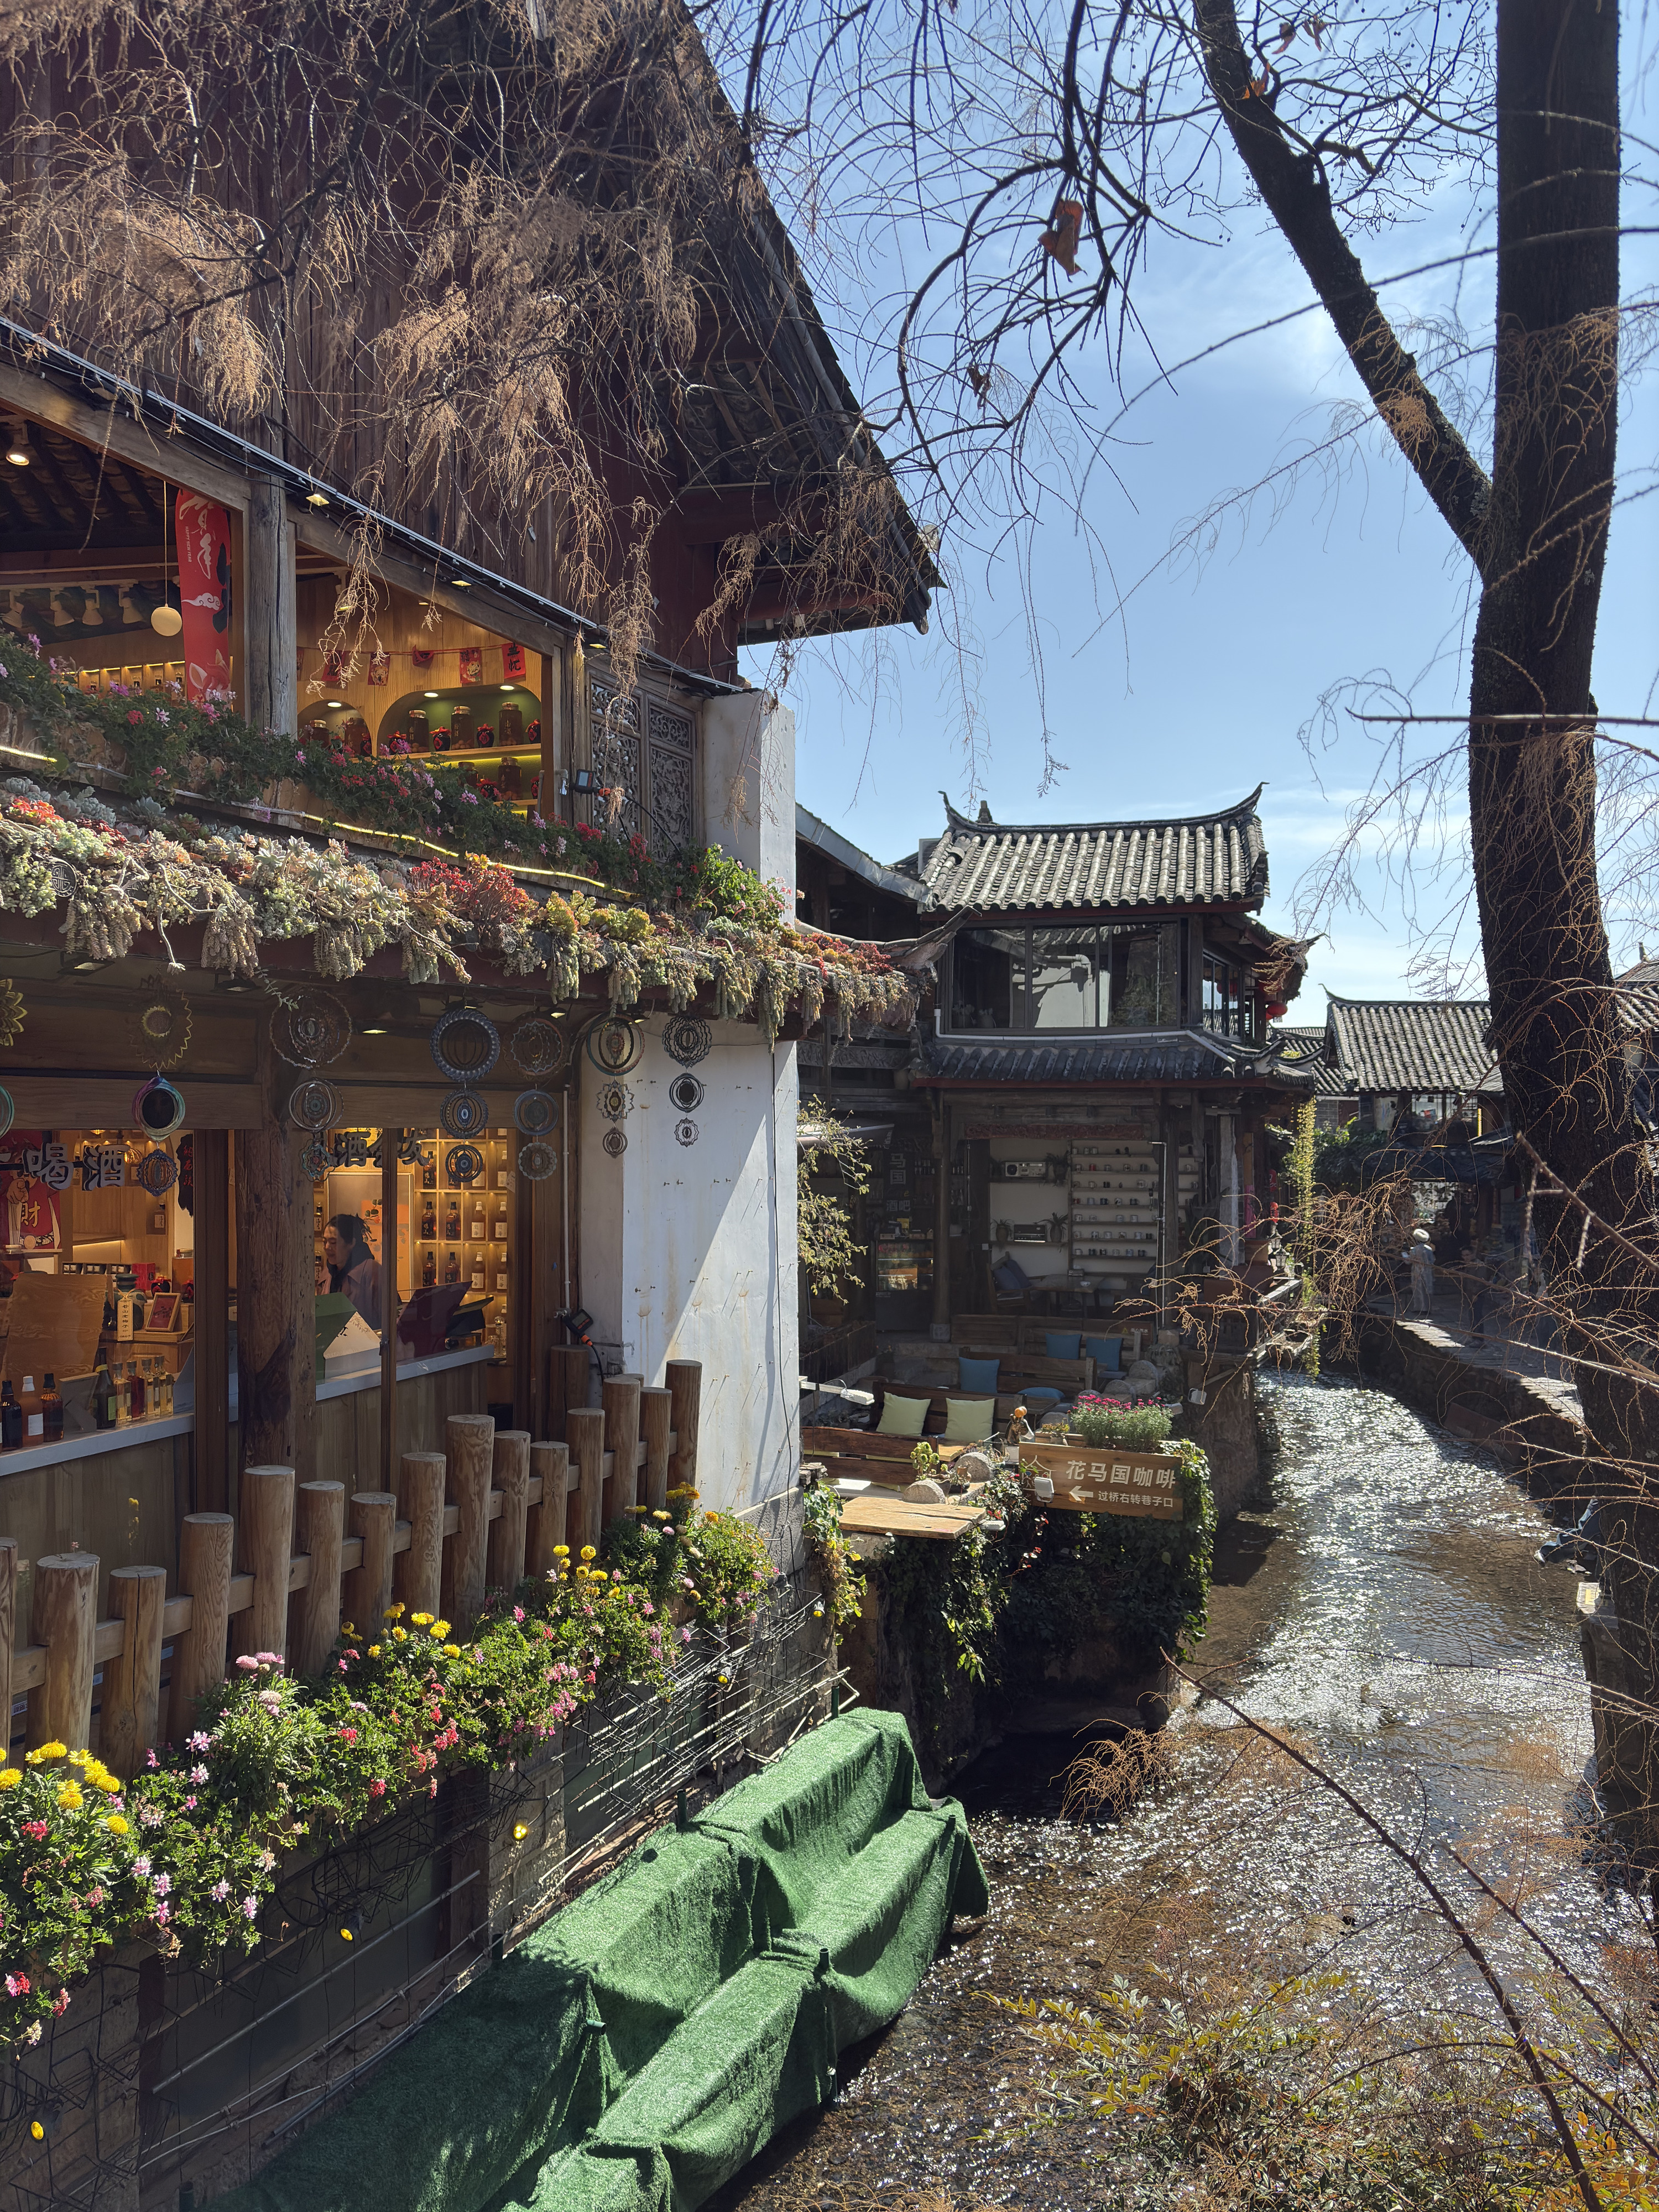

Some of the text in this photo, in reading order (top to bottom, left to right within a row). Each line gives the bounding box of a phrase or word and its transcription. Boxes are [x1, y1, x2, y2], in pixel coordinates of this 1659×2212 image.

[22, 1142, 131, 1191] 喝酒
[886, 1200, 911, 1212] 酒吧
[1065, 1460, 1176, 1489] 花马国咖啡
[1098, 1491, 1173, 1507] 过桥右转巷子口
